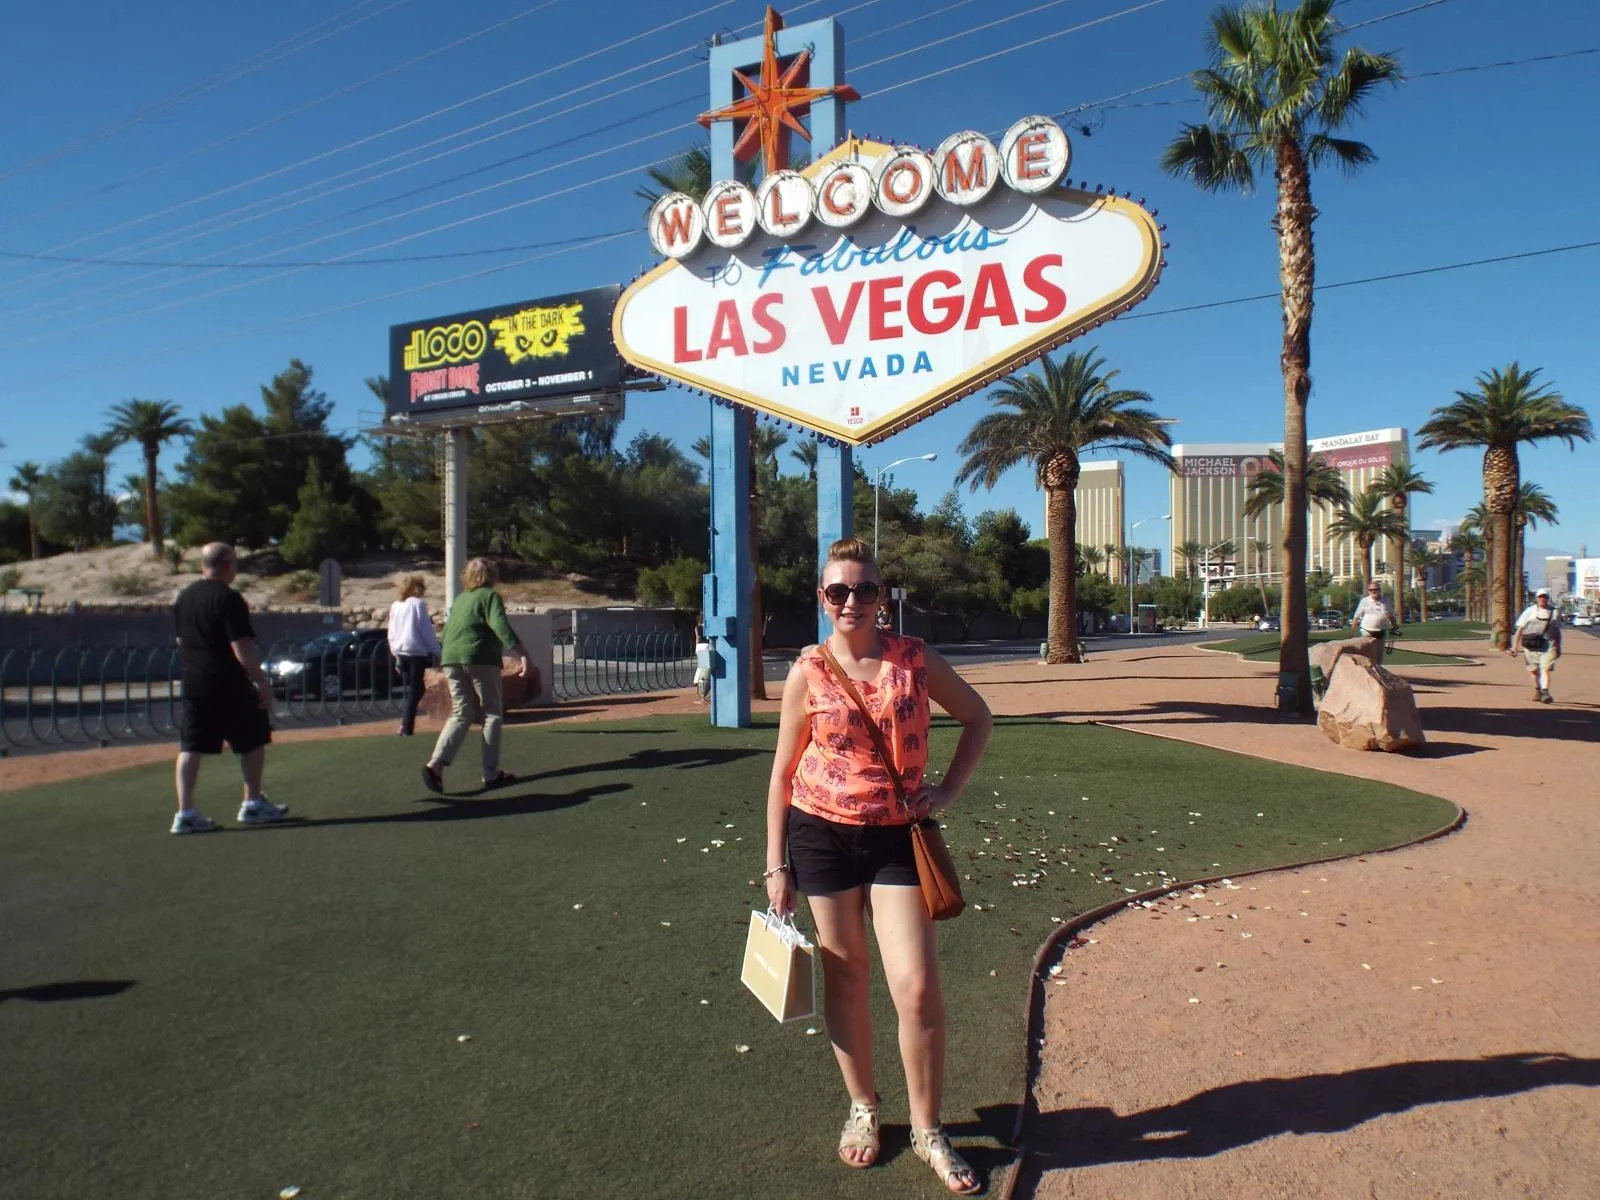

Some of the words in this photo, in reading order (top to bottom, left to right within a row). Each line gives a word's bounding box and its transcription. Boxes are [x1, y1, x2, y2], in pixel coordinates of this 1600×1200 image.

[657, 131, 1052, 248] WELCOME
[705, 263, 742, 289] TO
[758, 225, 1009, 289] Fabulous
[672, 292, 787, 364] LAS
[810, 254, 1067, 346] VEGAS
[508, 316, 518, 333] IN
[521, 315, 537, 330] THE
[540, 311, 564, 328] DARK
[781, 349, 934, 388] NEVADA
[485, 379, 525, 394] OCTOBER
[524, 378, 532, 388] 3
[538, 370, 586, 386] NOVEMBER
[587, 369, 593, 380] 1
[1320, 435, 1363, 449] MANDALAY
[1364, 432, 1381, 442] BAY
[1184, 457, 1237, 467] MICHAEL
[1184, 466, 1236, 476] JACKSON
